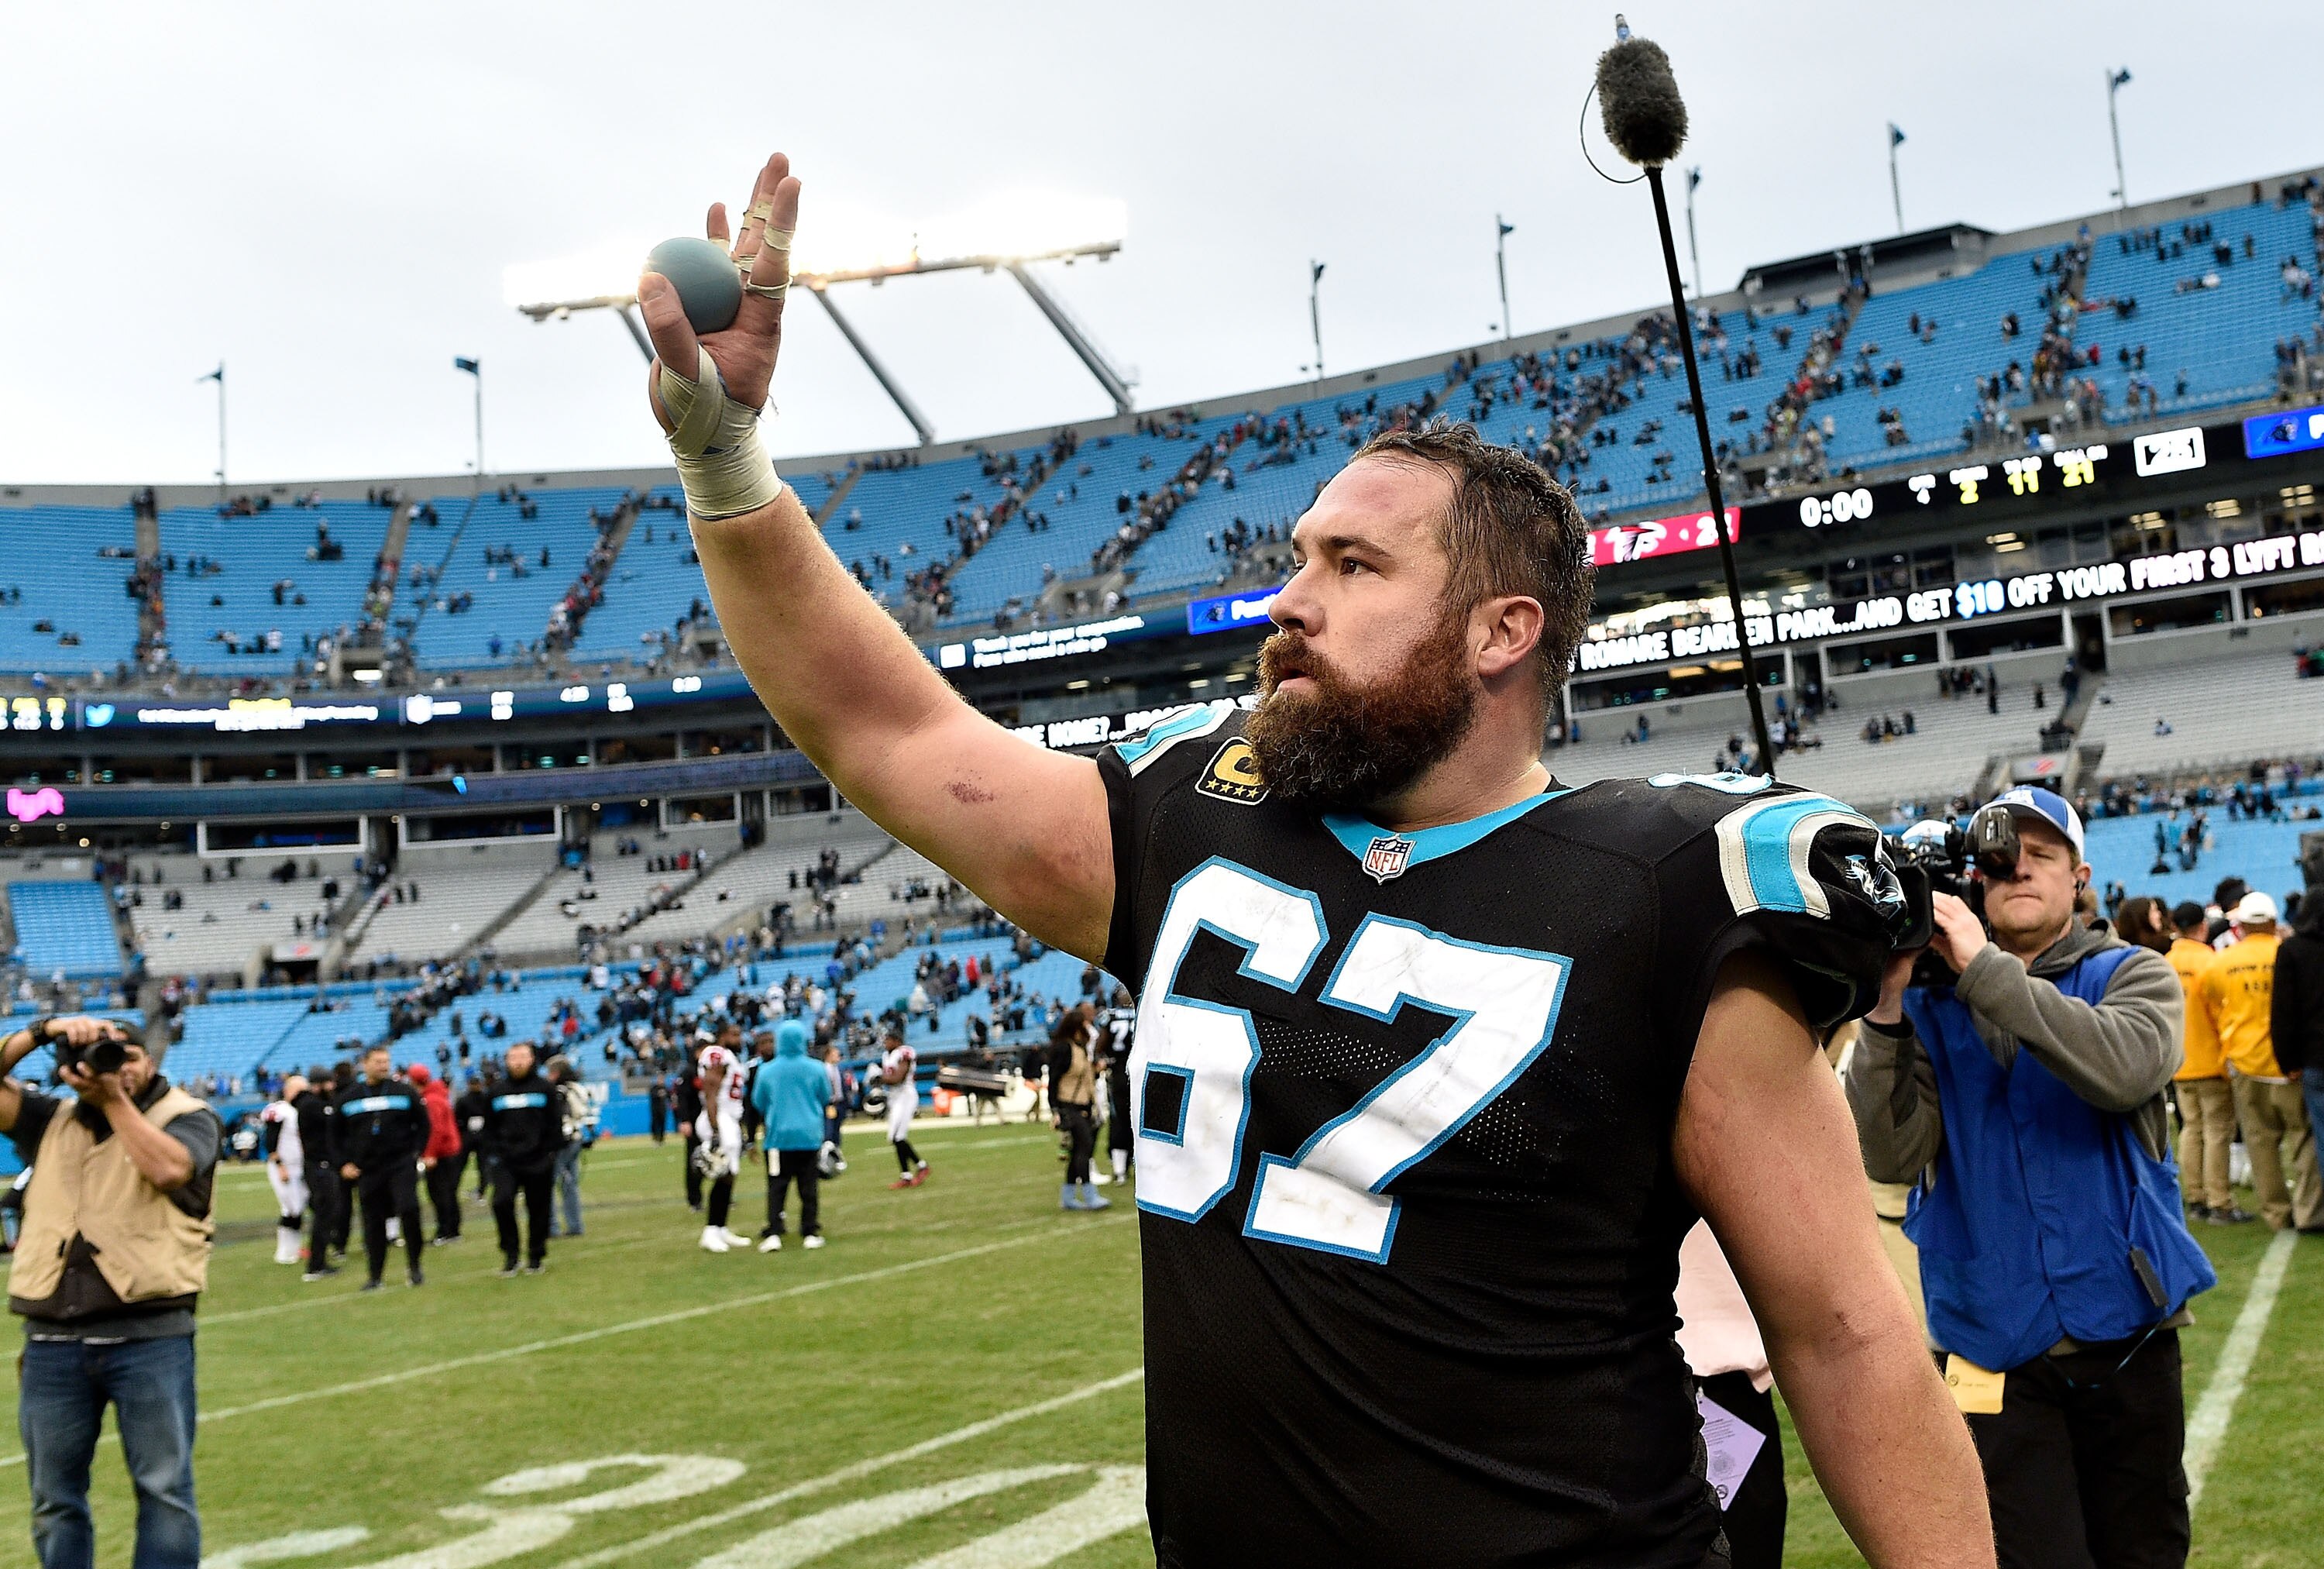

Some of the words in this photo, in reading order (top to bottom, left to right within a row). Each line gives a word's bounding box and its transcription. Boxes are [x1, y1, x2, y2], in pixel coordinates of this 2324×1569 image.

[1800, 488, 1873, 528] 0:00
[1580, 631, 1669, 671] ROMARE
[1906, 588, 1952, 622] GET
[1955, 579, 2004, 619] $10
[2008, 572, 2053, 607] OFF
[2056, 563, 2126, 600] YOUR
[2130, 549, 2205, 590] FIRST
[2210, 546, 2231, 579] 3
[2233, 535, 2296, 576] LYFT
[1369, 851, 1398, 872] NFL
[1127, 855, 1575, 1265] 67
